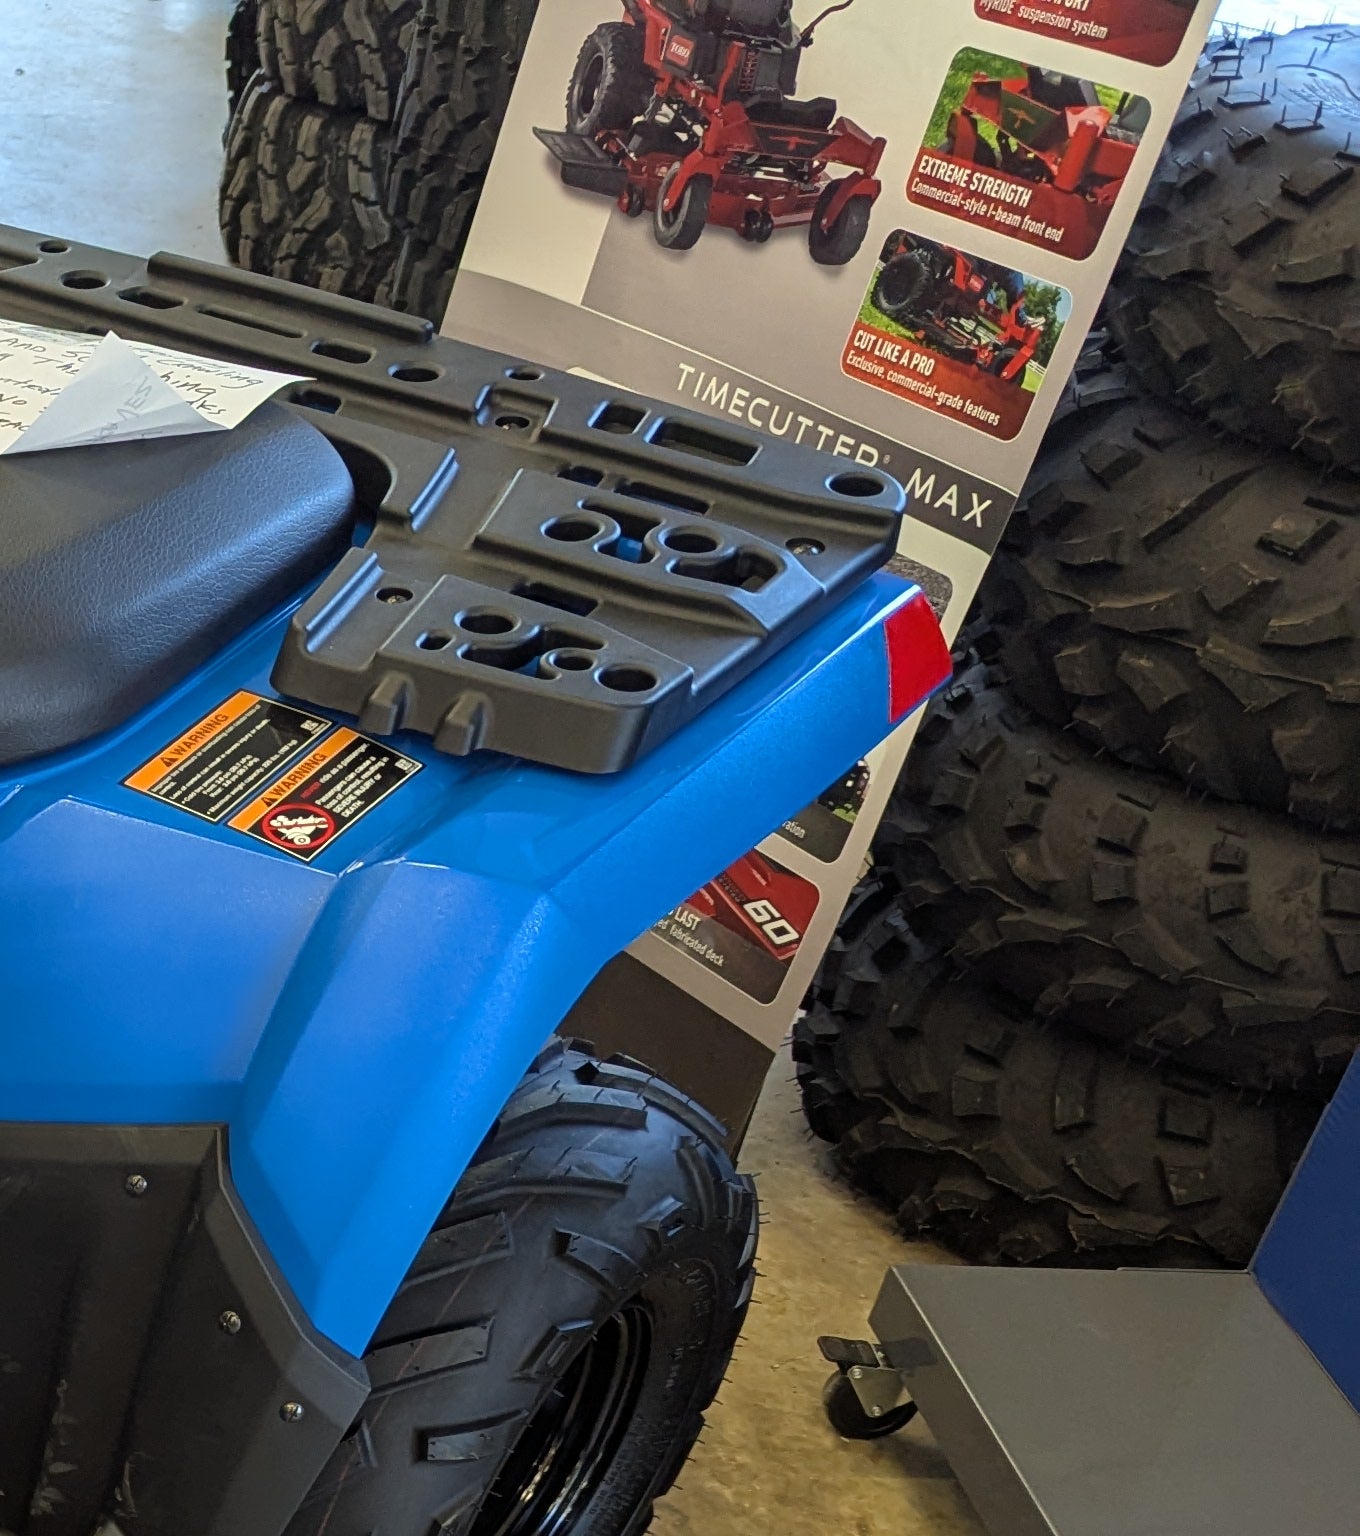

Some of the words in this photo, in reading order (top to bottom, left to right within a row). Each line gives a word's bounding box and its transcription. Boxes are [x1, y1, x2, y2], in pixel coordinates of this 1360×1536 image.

[1018, 5, 1071, 29] suspension
[1071, 19, 1108, 39] system
[918, 155, 971, 188] EXTREME
[970, 172, 1032, 208] STRENGTH
[912, 177, 988, 217] Commercial-style
[1022, 215, 1044, 237] front
[1044, 227, 1065, 242] end
[853, 329, 875, 350] CUT
[874, 338, 902, 363] LIKE
[900, 349, 911, 368] A
[910, 353, 935, 377] PRO
[847, 350, 885, 379] Exclusive,
[886, 369, 964, 411] commercial-grade
[964, 400, 1001, 426] features
[904, 467, 993, 528] MAX
[168, 712, 231, 757] WARNING
[269, 751, 328, 798] WARNING
[674, 906, 701, 930] LAST
[743, 900, 800, 945] 60
[669, 924, 707, 955] fabricated
[705, 945, 725, 967] deck
